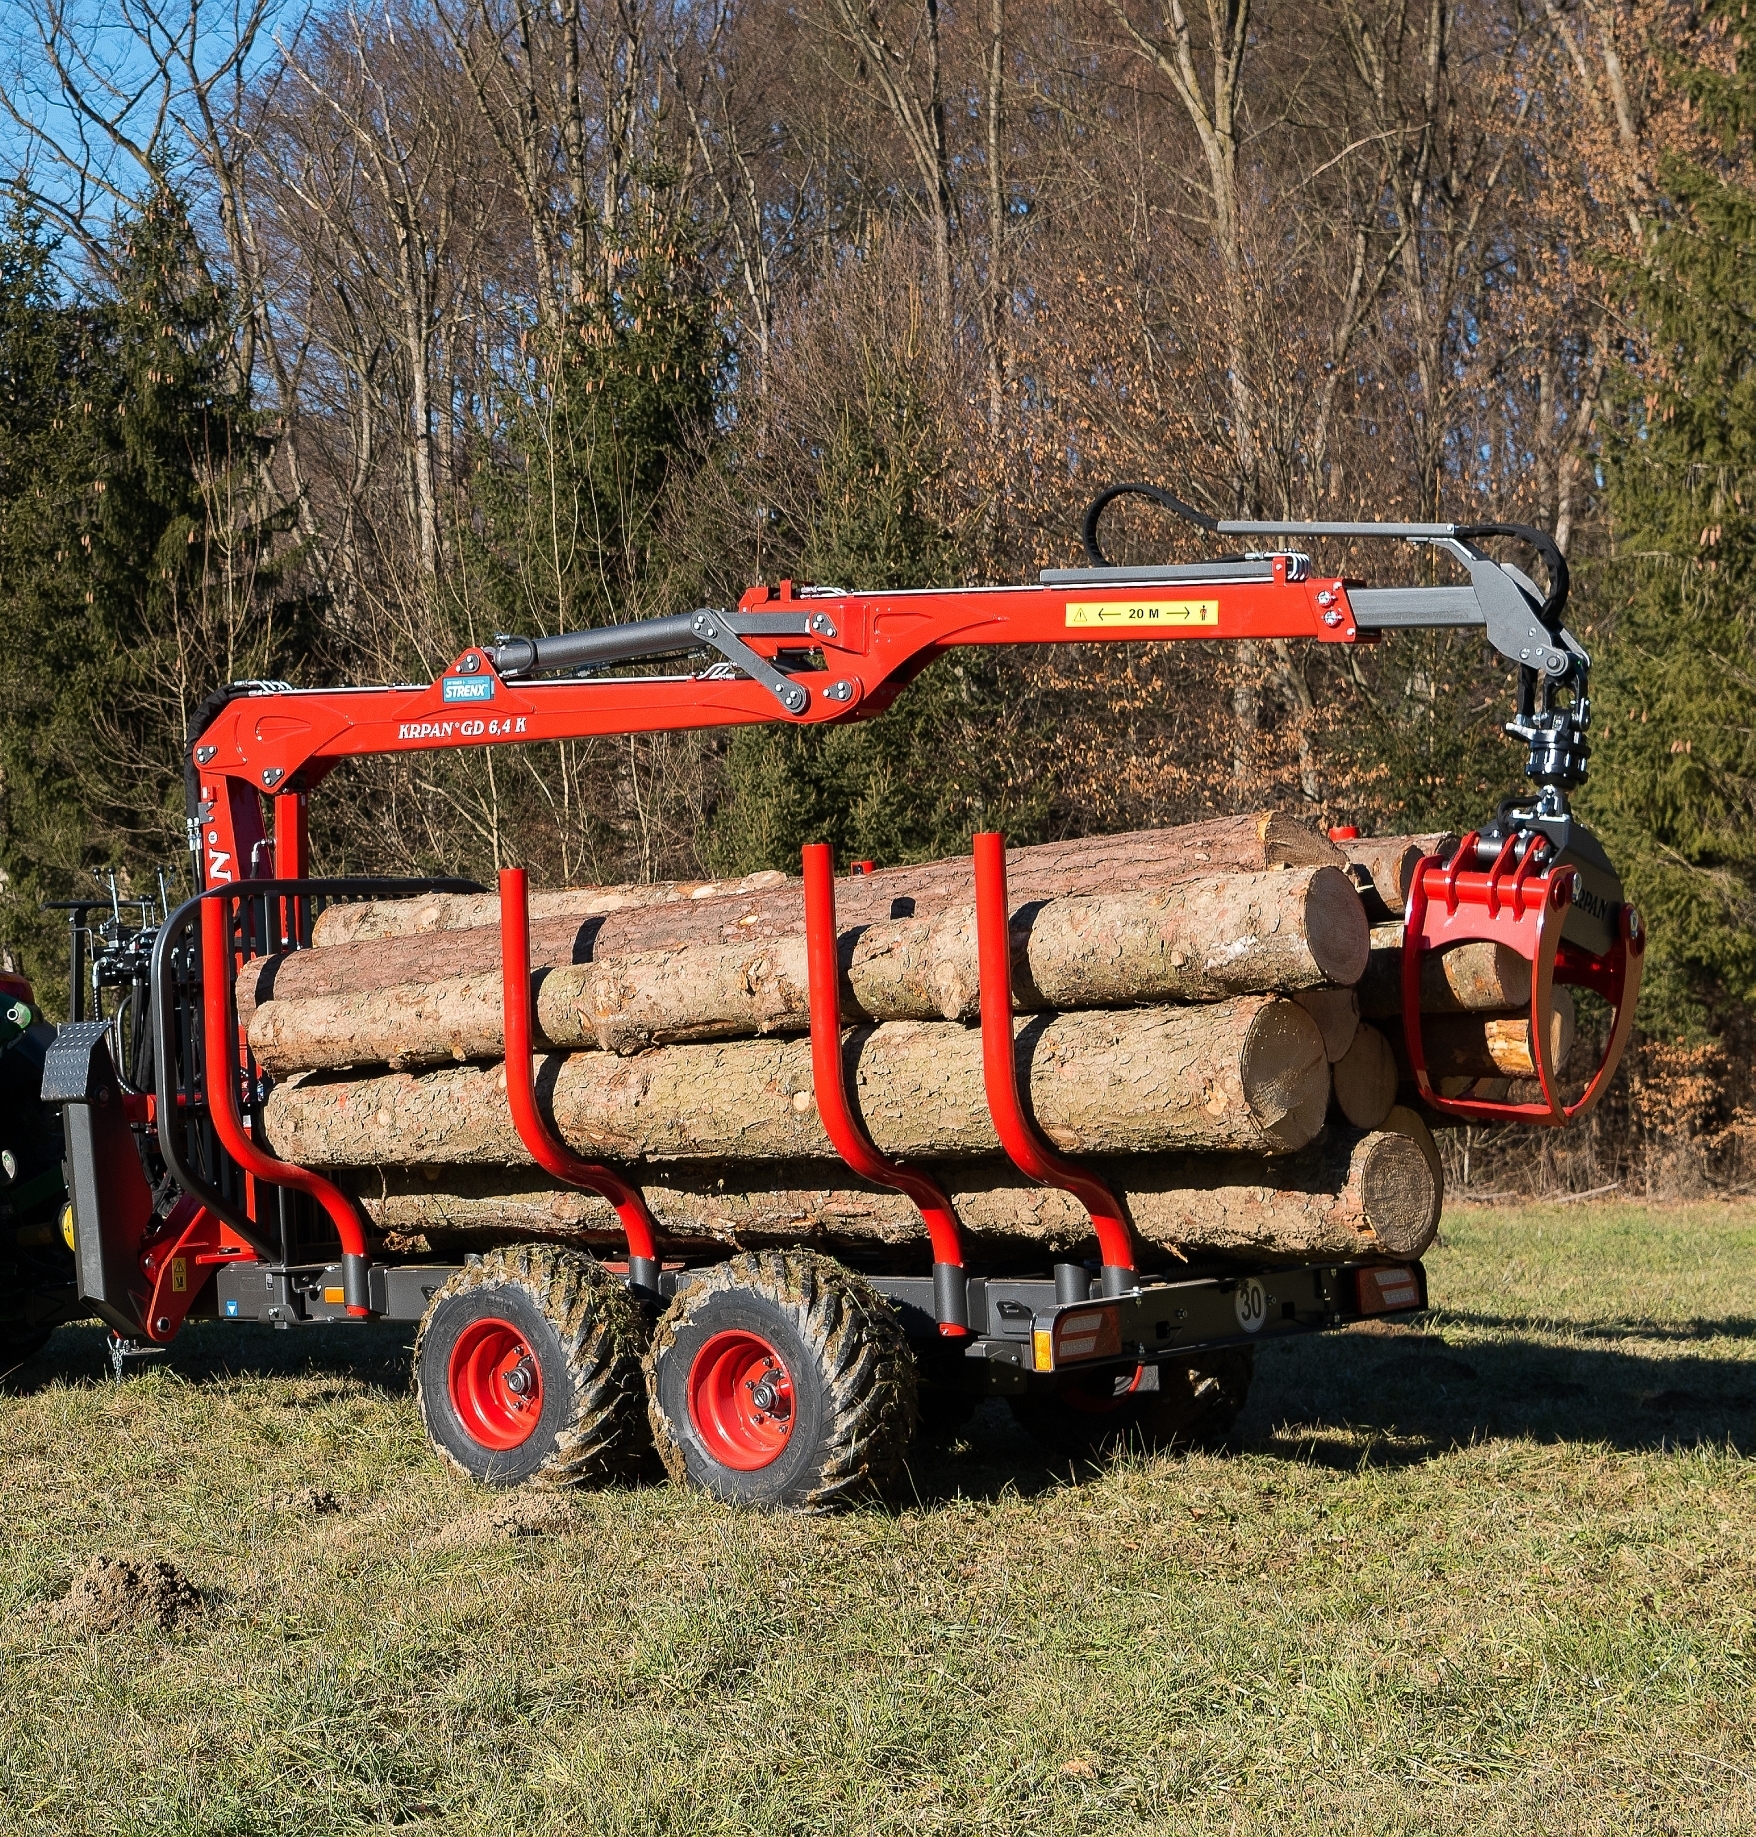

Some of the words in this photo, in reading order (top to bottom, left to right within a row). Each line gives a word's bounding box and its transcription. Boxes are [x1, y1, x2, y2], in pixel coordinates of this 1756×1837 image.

[1128, 608, 1144, 619] 20
[1148, 608, 1160, 619] M
[460, 719, 485, 735] GD
[488, 718, 511, 737] 6,4
[514, 717, 527, 733] K
[1239, 1286, 1262, 1321] 30
